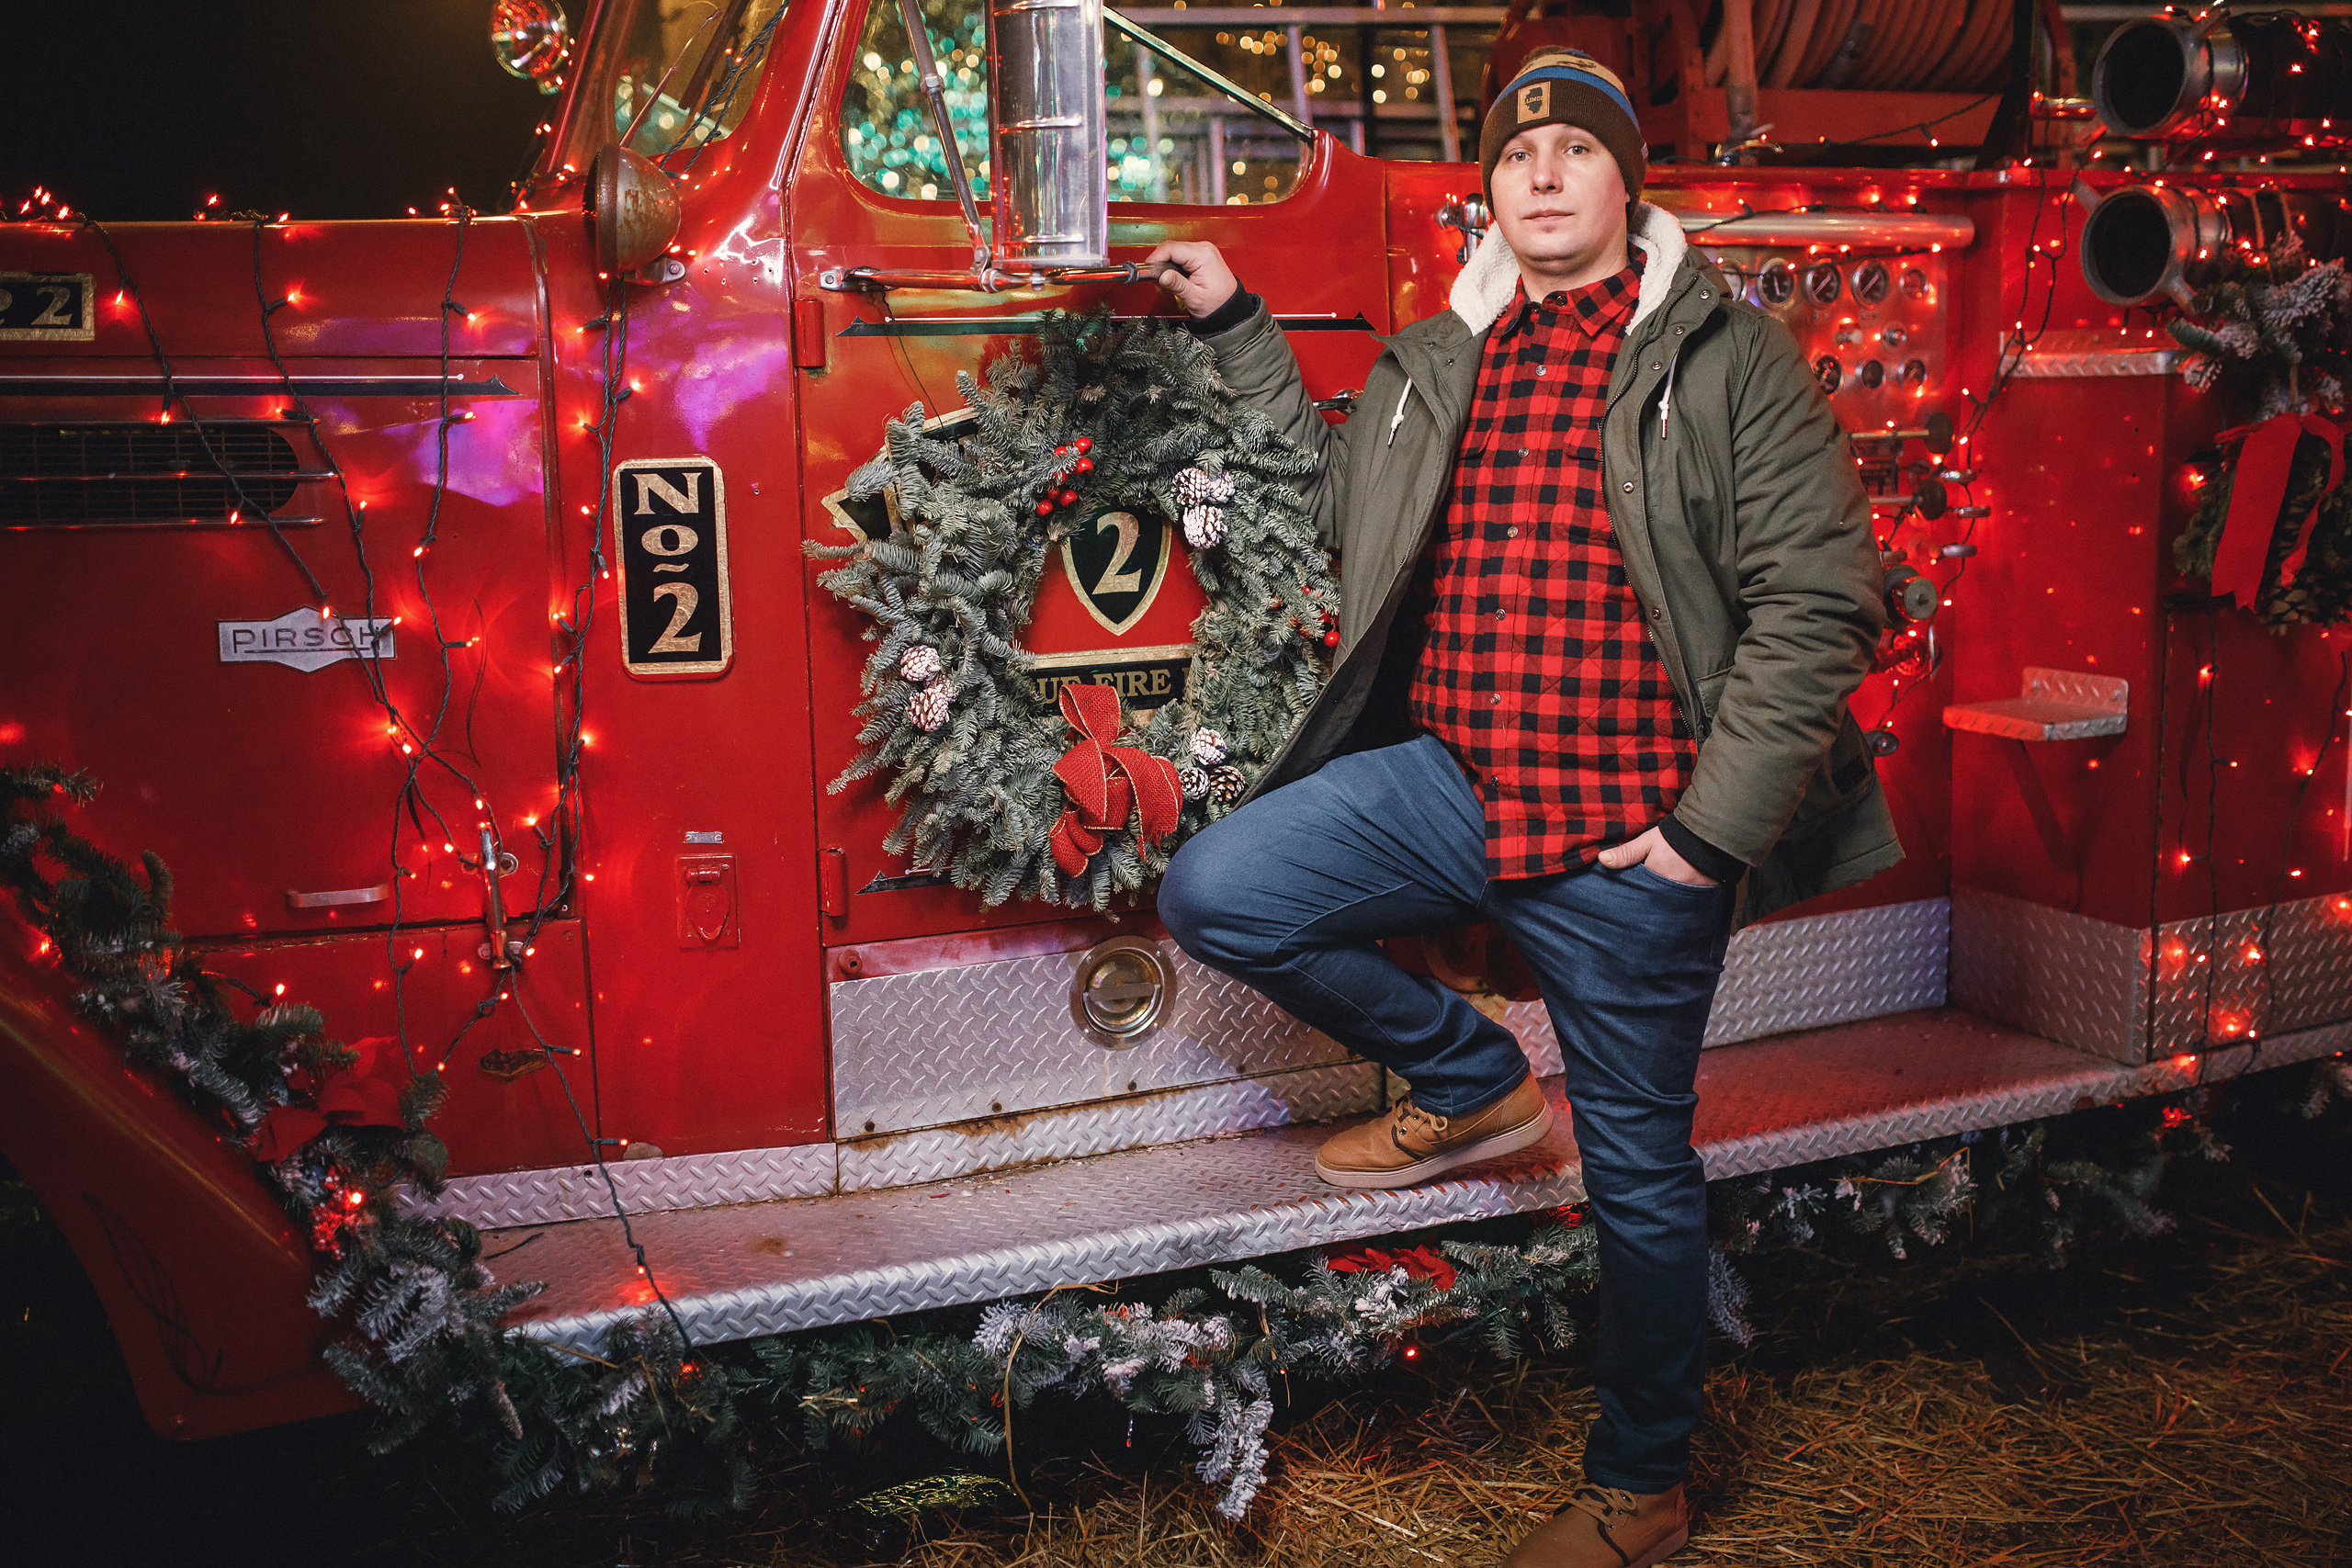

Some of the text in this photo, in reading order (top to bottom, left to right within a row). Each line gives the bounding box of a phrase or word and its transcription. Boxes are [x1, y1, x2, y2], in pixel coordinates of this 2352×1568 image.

[30, 285, 73, 325] 2
[1091, 511, 1143, 595] 2
[232, 626, 380, 654] PIRSCH
[1092, 668, 1172, 698] FIRE
